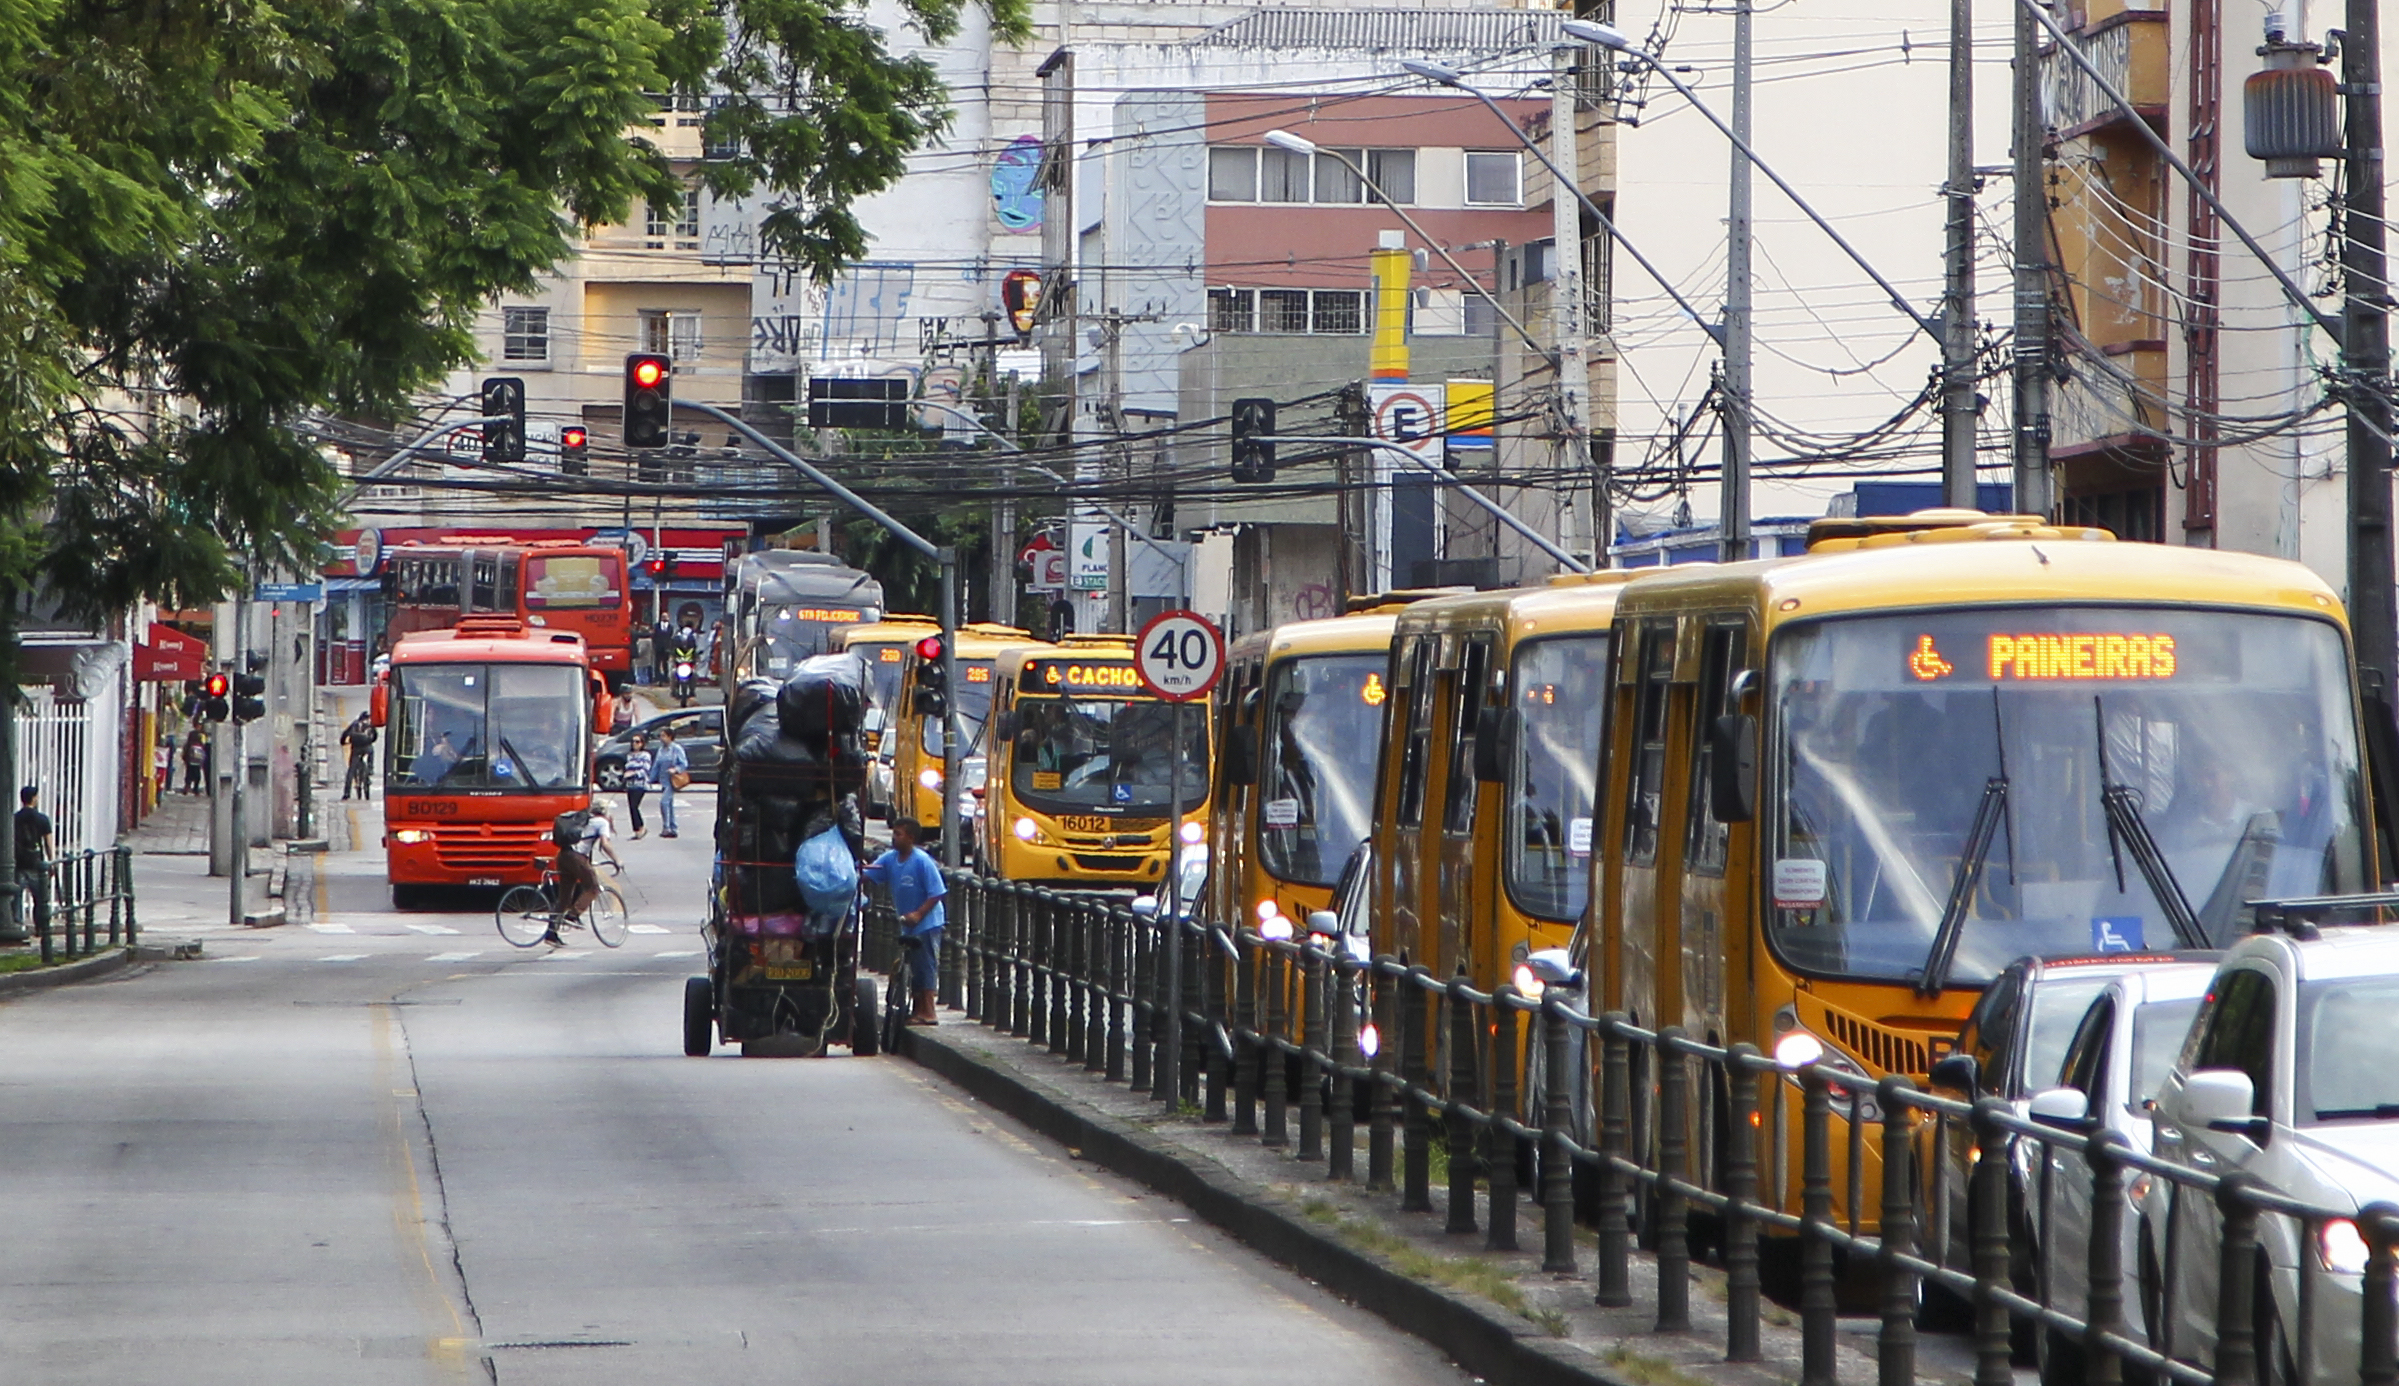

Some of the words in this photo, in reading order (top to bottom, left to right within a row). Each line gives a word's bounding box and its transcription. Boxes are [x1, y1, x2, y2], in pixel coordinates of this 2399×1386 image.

[1394, 408, 1418, 439] E
[1150, 629, 1207, 670] 40
[1990, 635, 2177, 679] PAINEIRAS
[1066, 665, 1145, 688] CACHO
[1163, 675, 1192, 685] km/h
[408, 801, 458, 815] BD129
[1062, 816, 1105, 830] 16012
